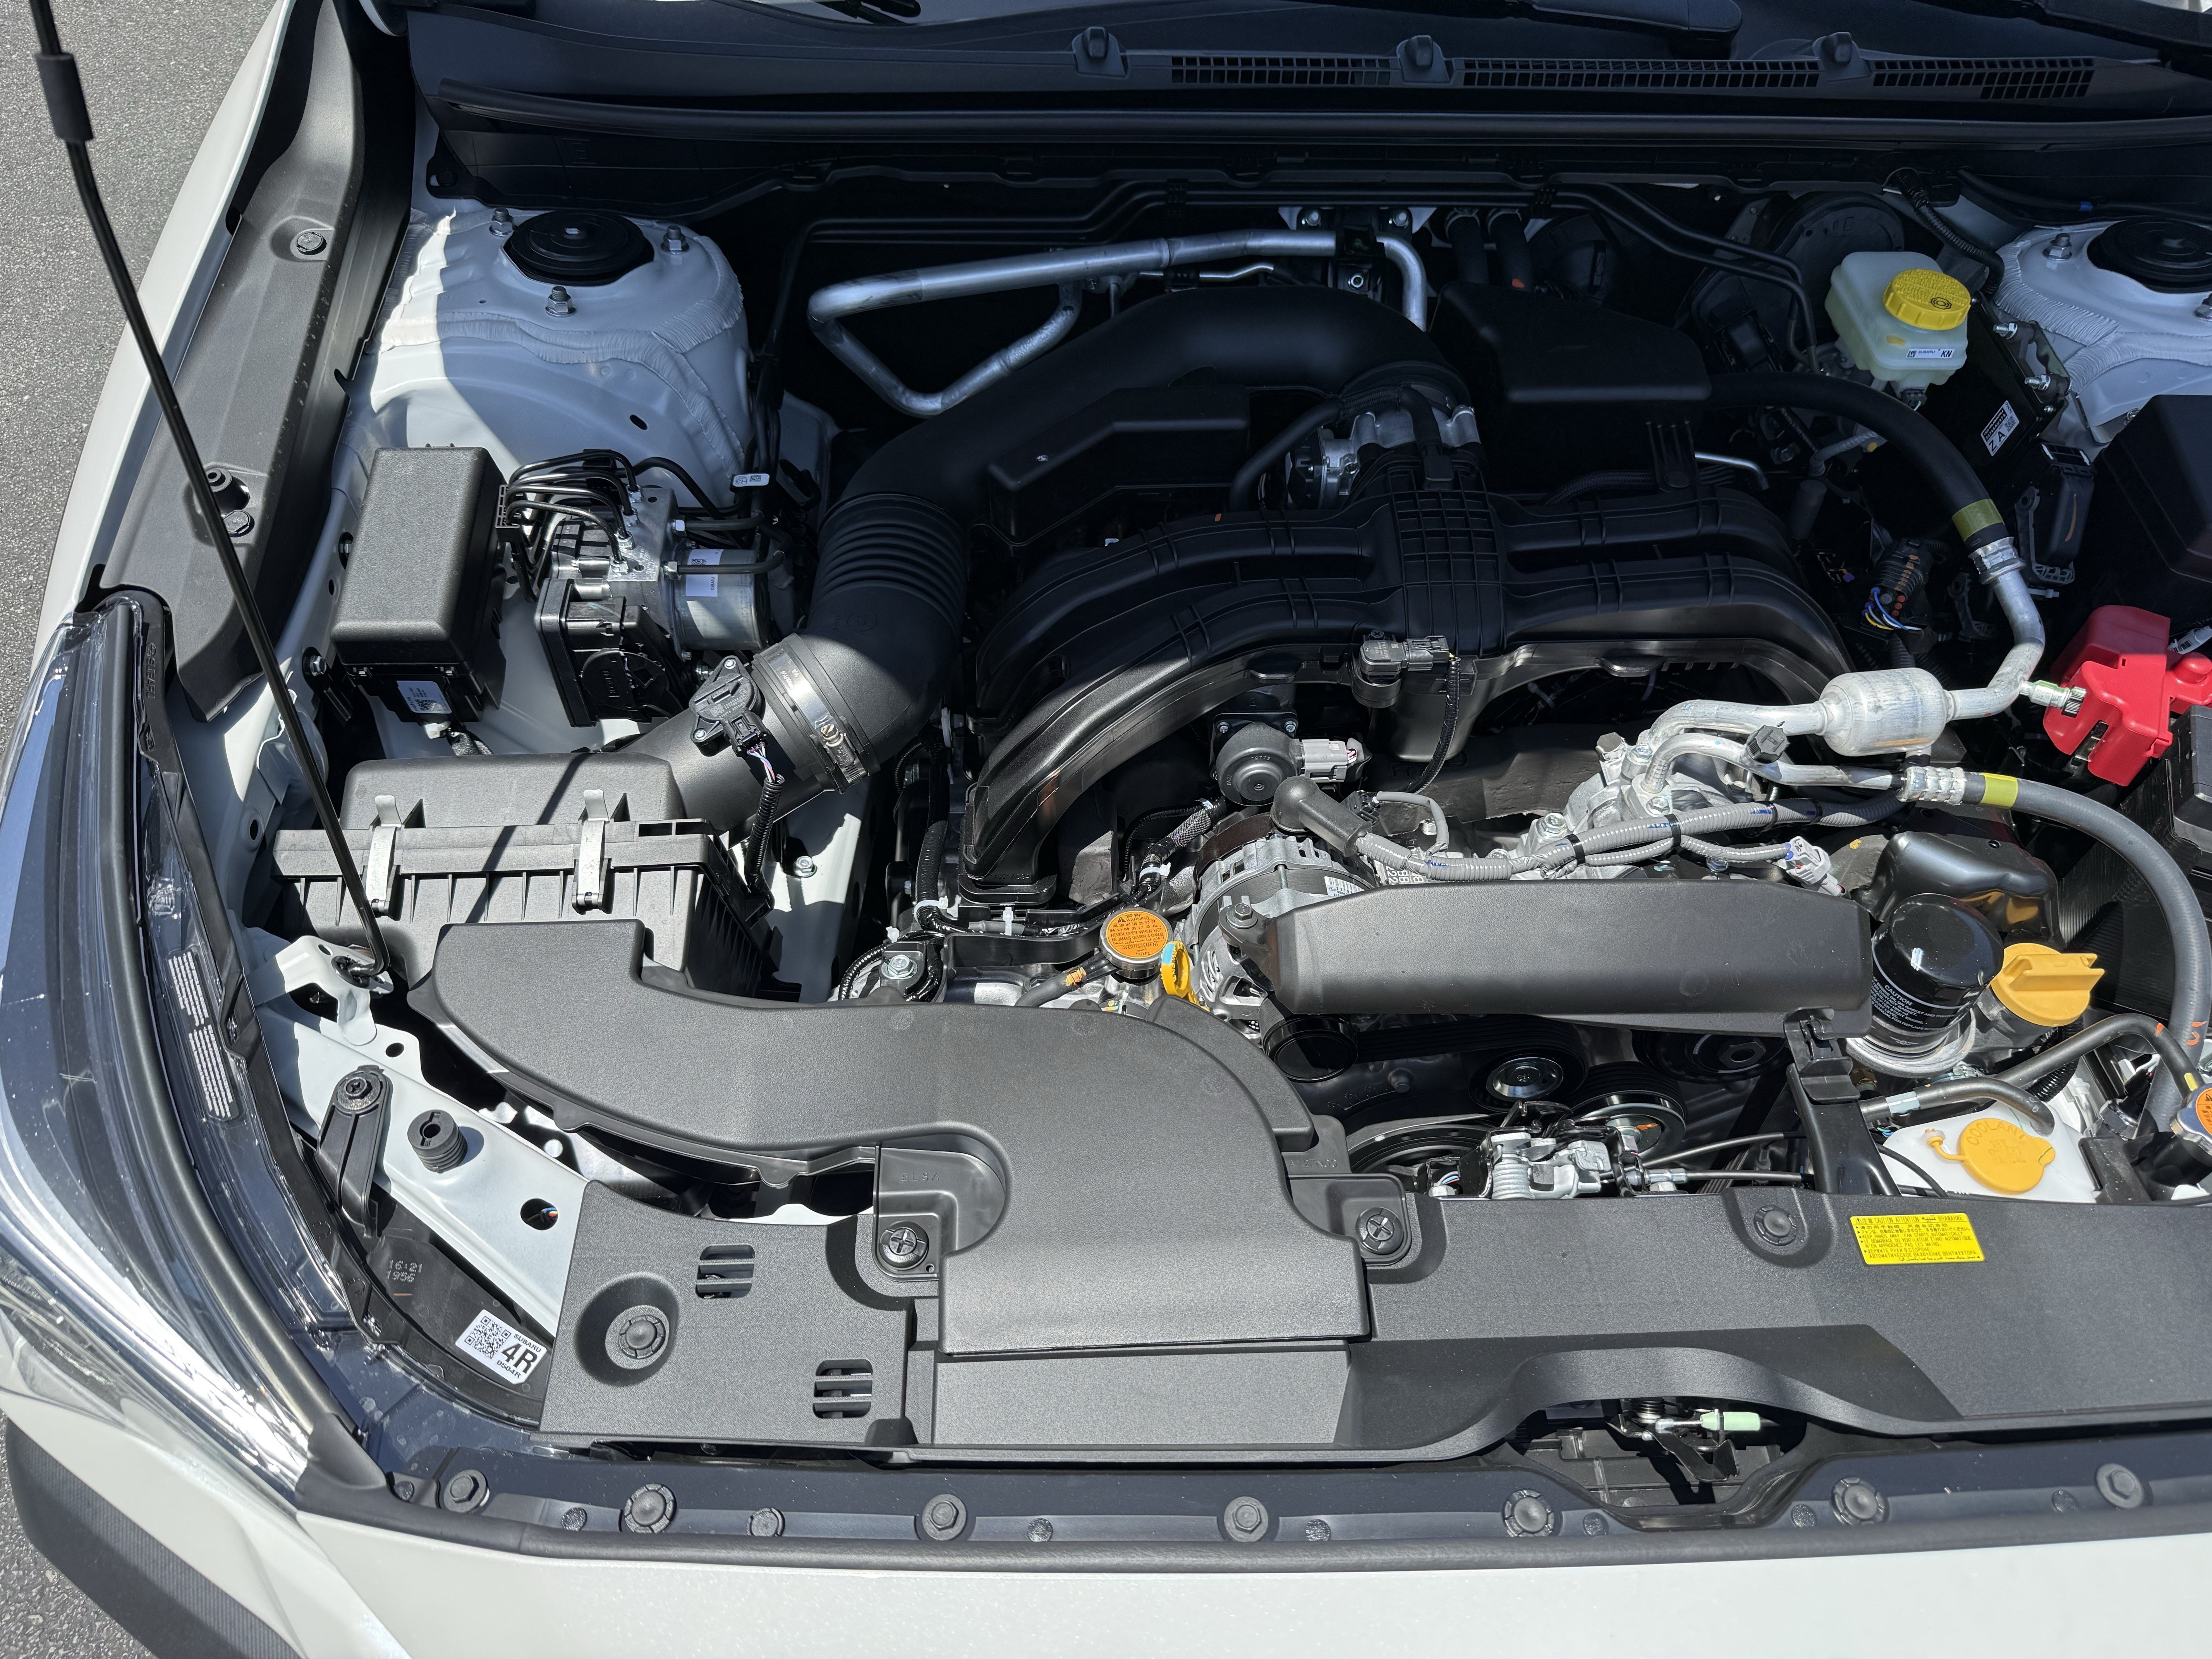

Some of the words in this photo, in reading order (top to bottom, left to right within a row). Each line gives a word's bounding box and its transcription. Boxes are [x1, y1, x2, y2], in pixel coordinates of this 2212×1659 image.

[146, 657, 155, 699] SUBARU
[1885, 985, 1913, 1006] CAUTION
[1966, 1121, 2028, 1145] COOLANT
[514, 1333, 542, 1353] SUBARU
[501, 1343, 538, 1374] 4R
